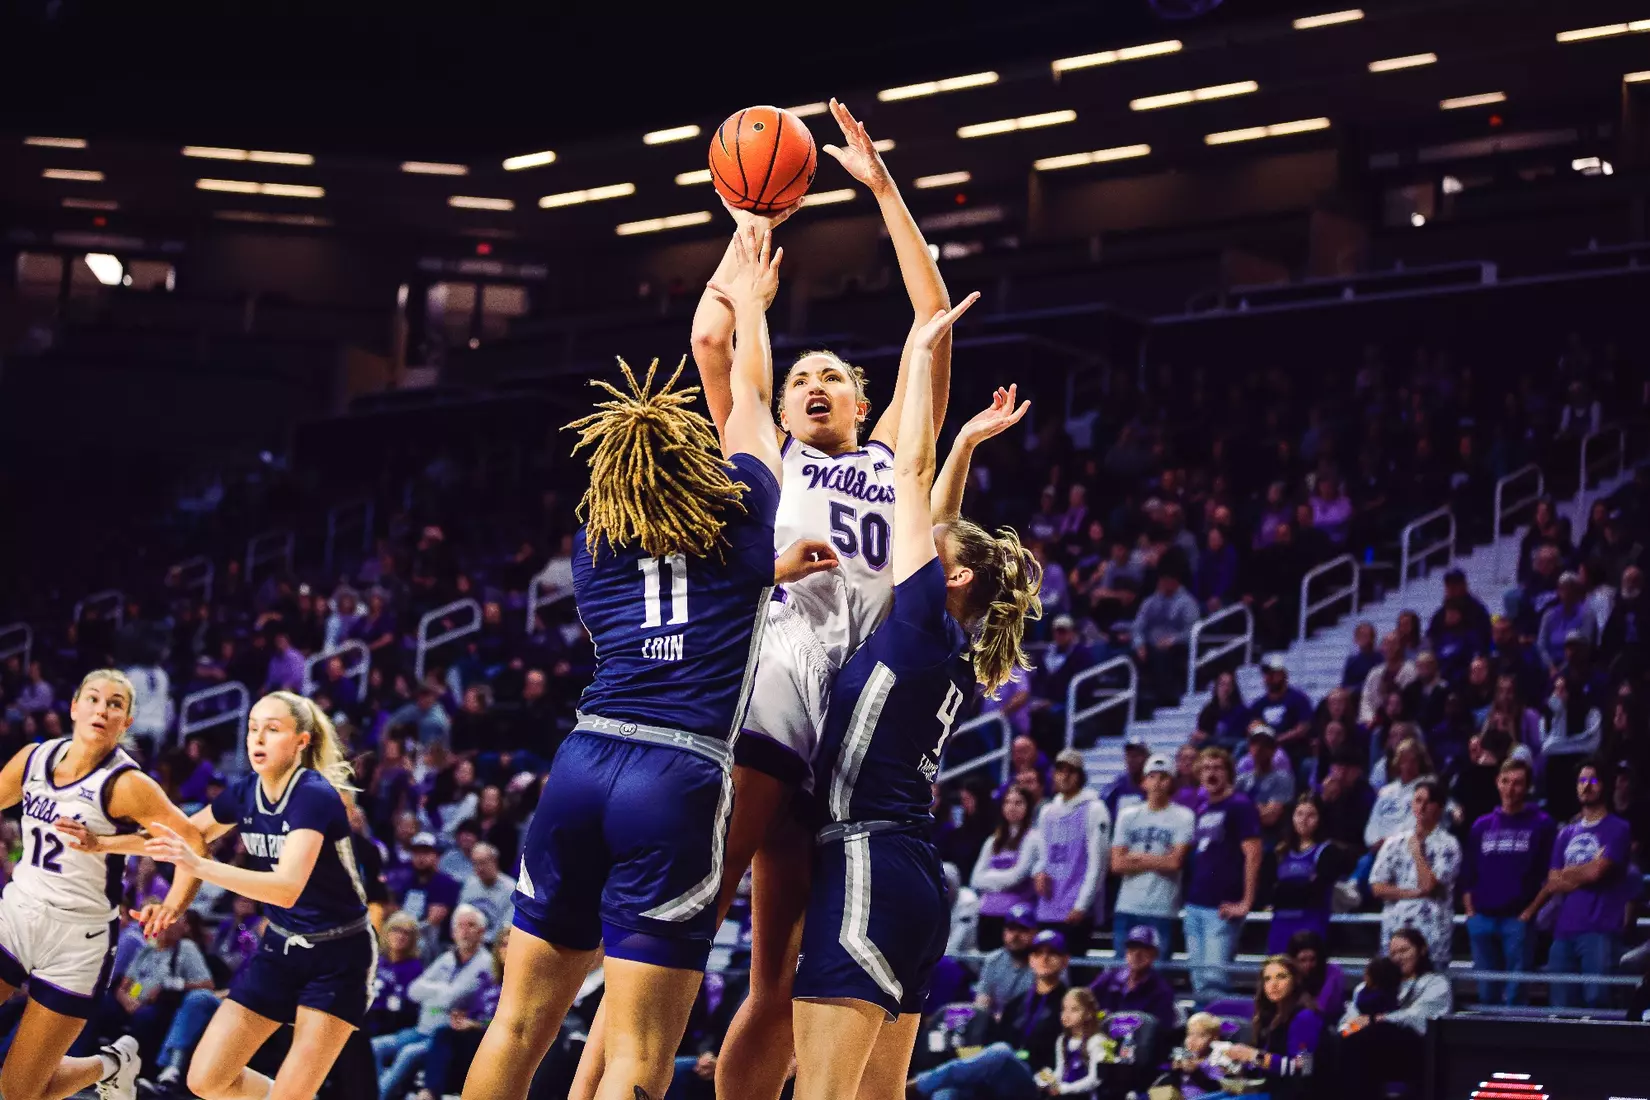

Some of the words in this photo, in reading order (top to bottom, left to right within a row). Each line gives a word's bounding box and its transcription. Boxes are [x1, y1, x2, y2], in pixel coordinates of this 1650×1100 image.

[829, 500, 891, 571] 50
[637, 553, 688, 629] 11
[31, 827, 64, 874] 12
